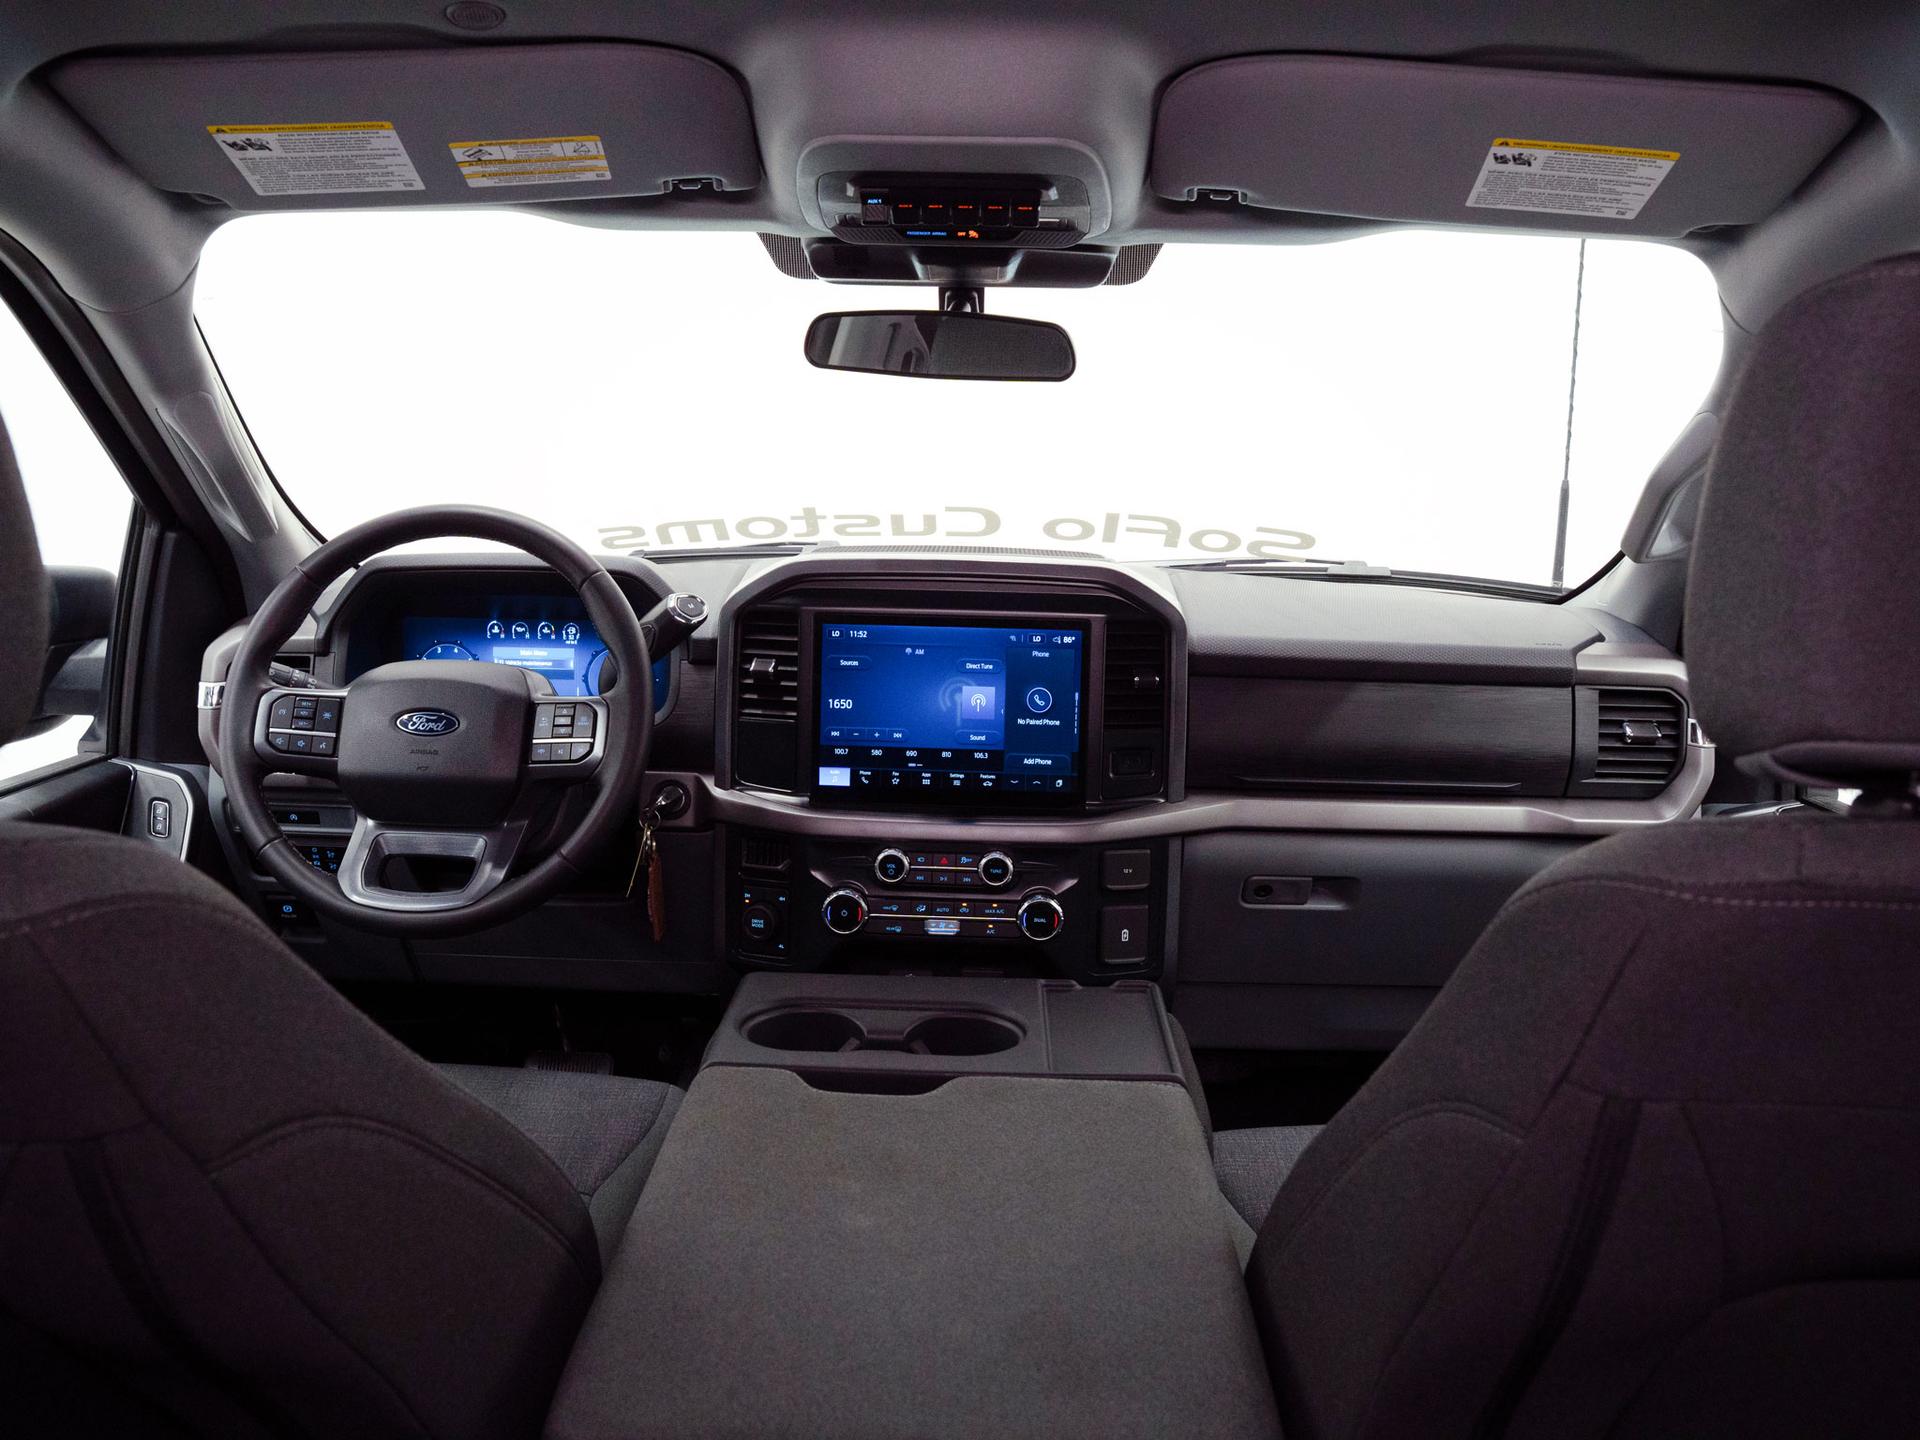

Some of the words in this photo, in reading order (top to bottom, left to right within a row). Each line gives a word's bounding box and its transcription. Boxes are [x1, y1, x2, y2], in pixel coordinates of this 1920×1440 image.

[850, 630, 868, 638] 11:52
[1032, 650, 1050, 658] Phone
[840, 659, 859, 667] Sources
[965, 662, 981, 670] Direct
[981, 662, 993, 670] Tune
[828, 698, 853, 710] 1650
[408, 714, 447, 731] Ford
[1026, 718, 1042, 726] Paired
[1035, 758, 1052, 766] Phone
